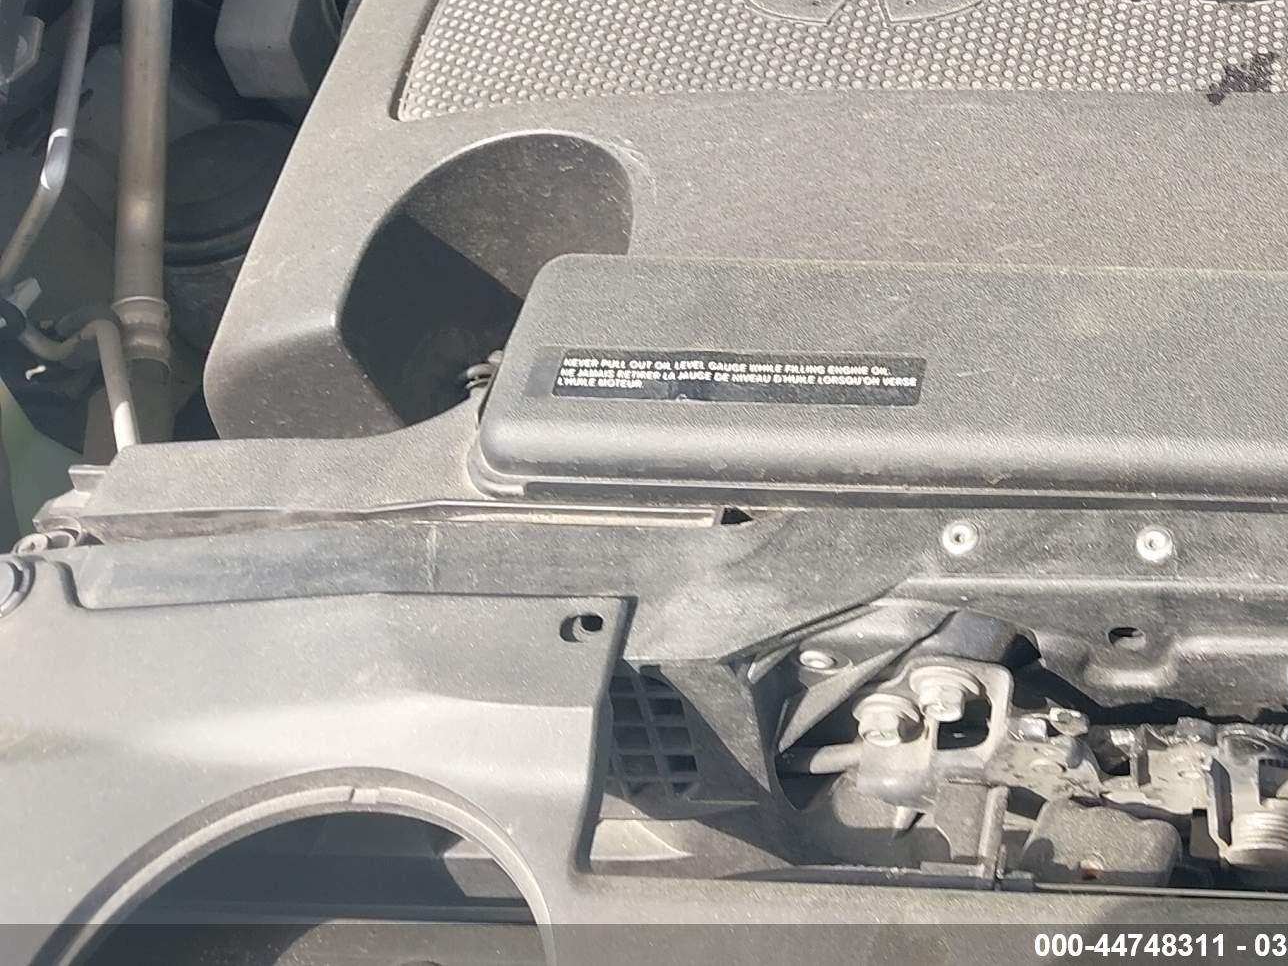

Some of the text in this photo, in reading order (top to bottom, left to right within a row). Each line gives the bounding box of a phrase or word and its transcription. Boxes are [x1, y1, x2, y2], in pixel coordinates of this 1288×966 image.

[563, 358, 599, 368] NEVER
[600, 359, 626, 369] PULL
[629, 359, 653, 370] OUT
[654, 360, 672, 371] OIL
[674, 360, 705, 371] LEVEL
[708, 361, 747, 372] GAUGE
[749, 363, 783, 374] WHILE
[784, 364, 826, 375] FILLING
[827, 365, 869, 376] ENGINE
[560, 368, 576, 377] NE
[577, 368, 615, 379] JAMAIS
[616, 369, 661, 380] RETIRER
[662, 371, 676, 380] LA
[677, 371, 712, 381] JAUGE
[714, 372, 729, 382] DE
[731, 373, 771, 384] NIVEAU
[882, 377, 917, 387] VERSE
